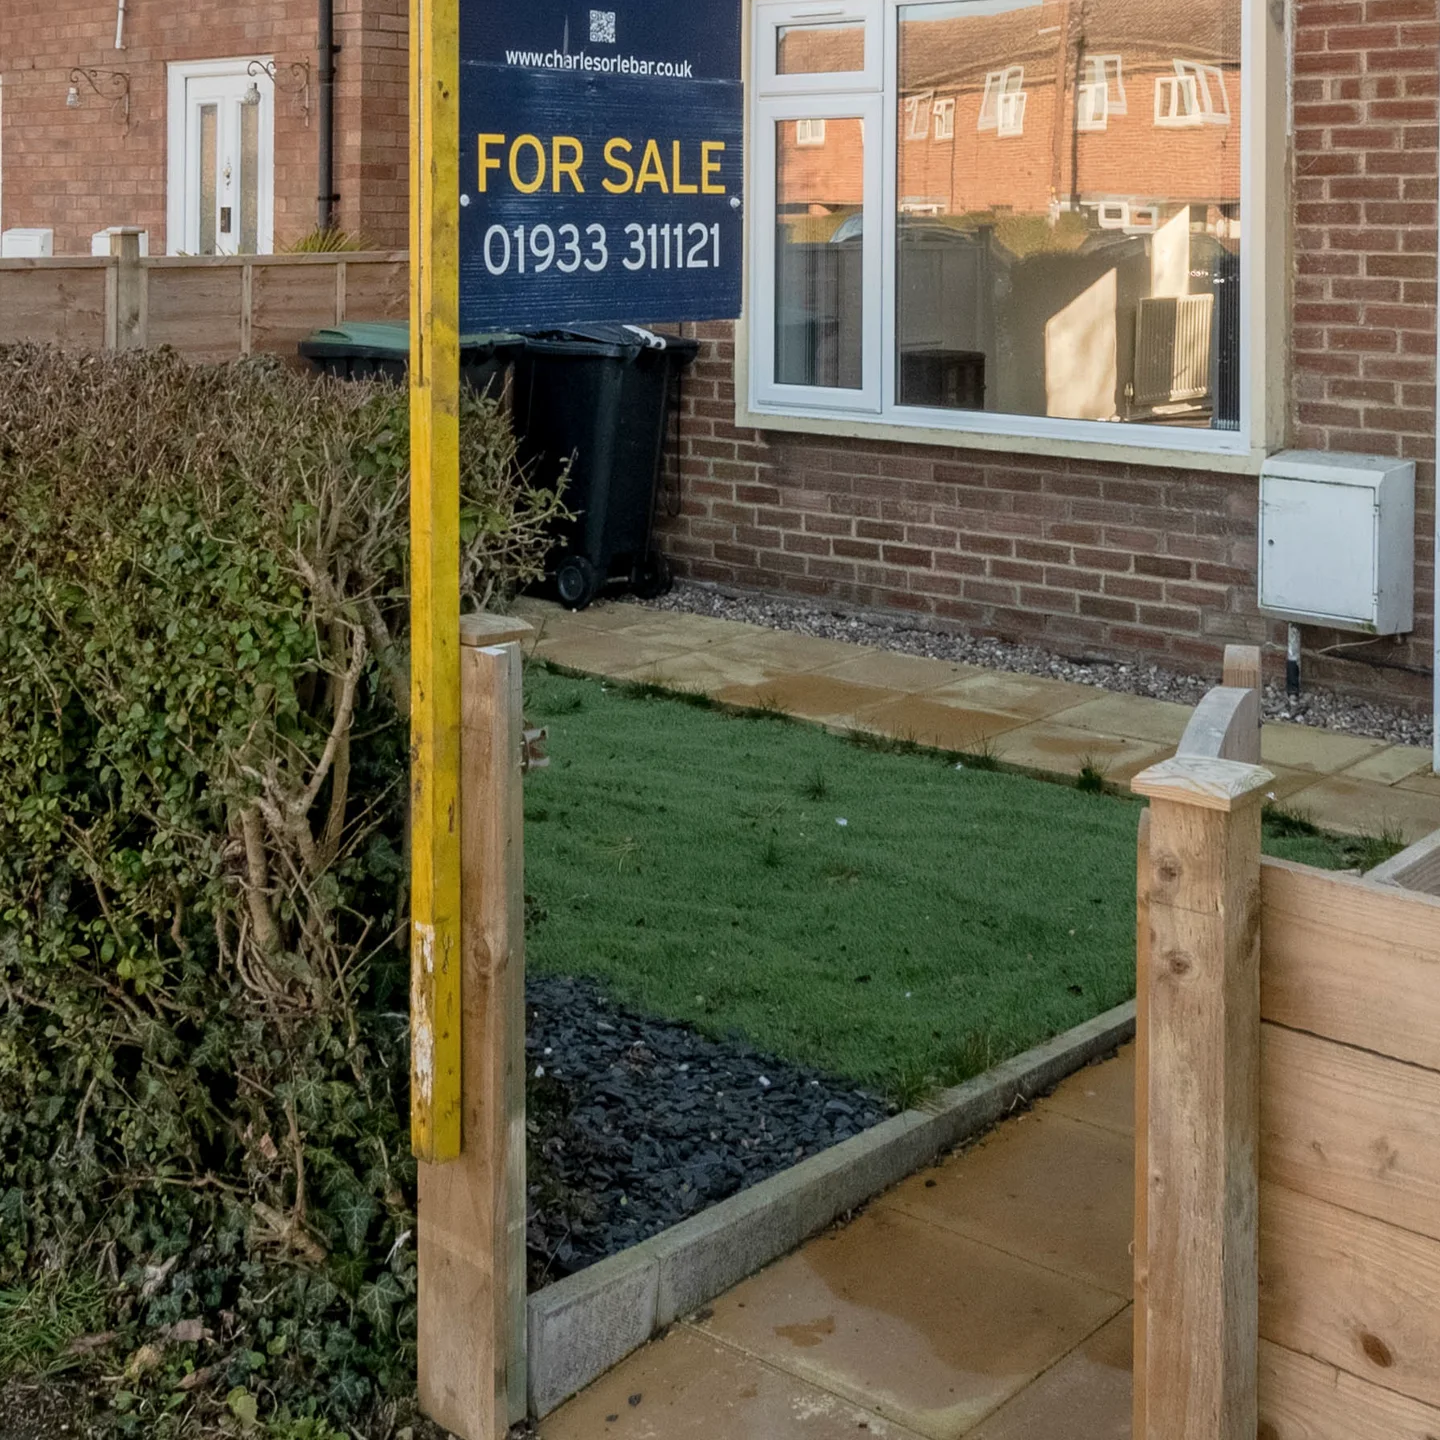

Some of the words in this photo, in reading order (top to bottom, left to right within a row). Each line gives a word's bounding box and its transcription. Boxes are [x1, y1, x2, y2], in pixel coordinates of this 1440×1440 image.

[506, 49, 692, 78] www.charlesorlebar.co.uk
[478, 133, 585, 194] FOR
[601, 137, 726, 194] SALE
[483, 223, 608, 276] 01933
[622, 222, 720, 270] 311121
